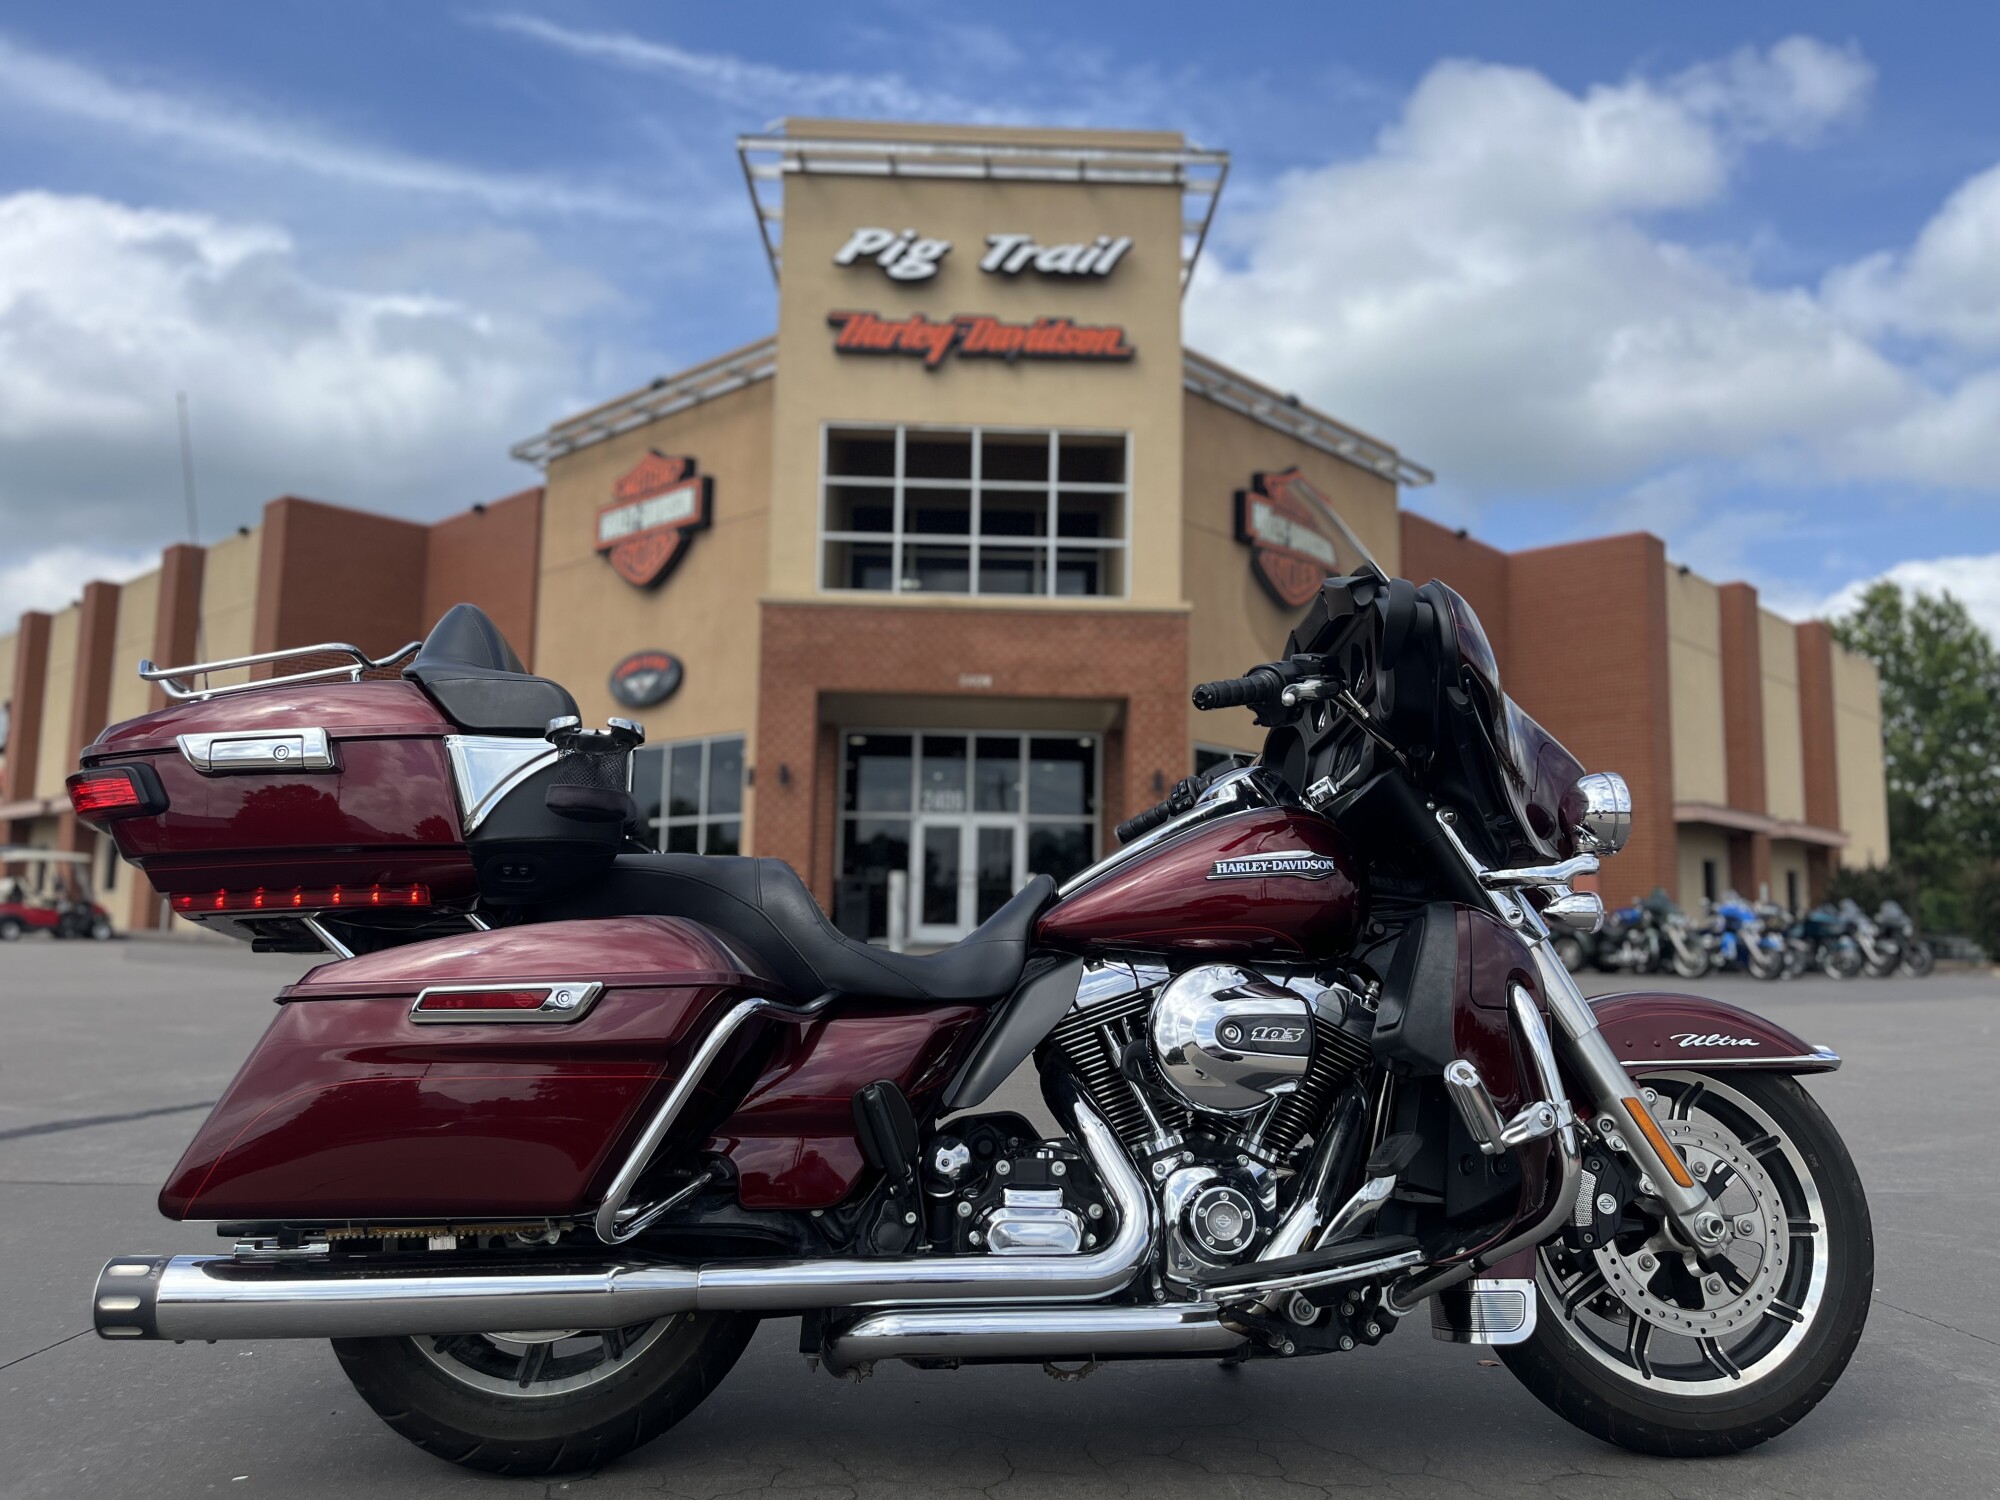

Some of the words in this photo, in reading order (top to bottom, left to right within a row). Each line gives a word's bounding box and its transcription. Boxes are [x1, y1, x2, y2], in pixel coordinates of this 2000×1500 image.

[833, 227, 952, 280] Pig
[978, 233, 1133, 277] Trail
[1216, 860, 1335, 874] HARLEY-DAVIDSON
[1251, 1026, 1306, 1043] 103
[1669, 1033, 1760, 1048] Ultra
